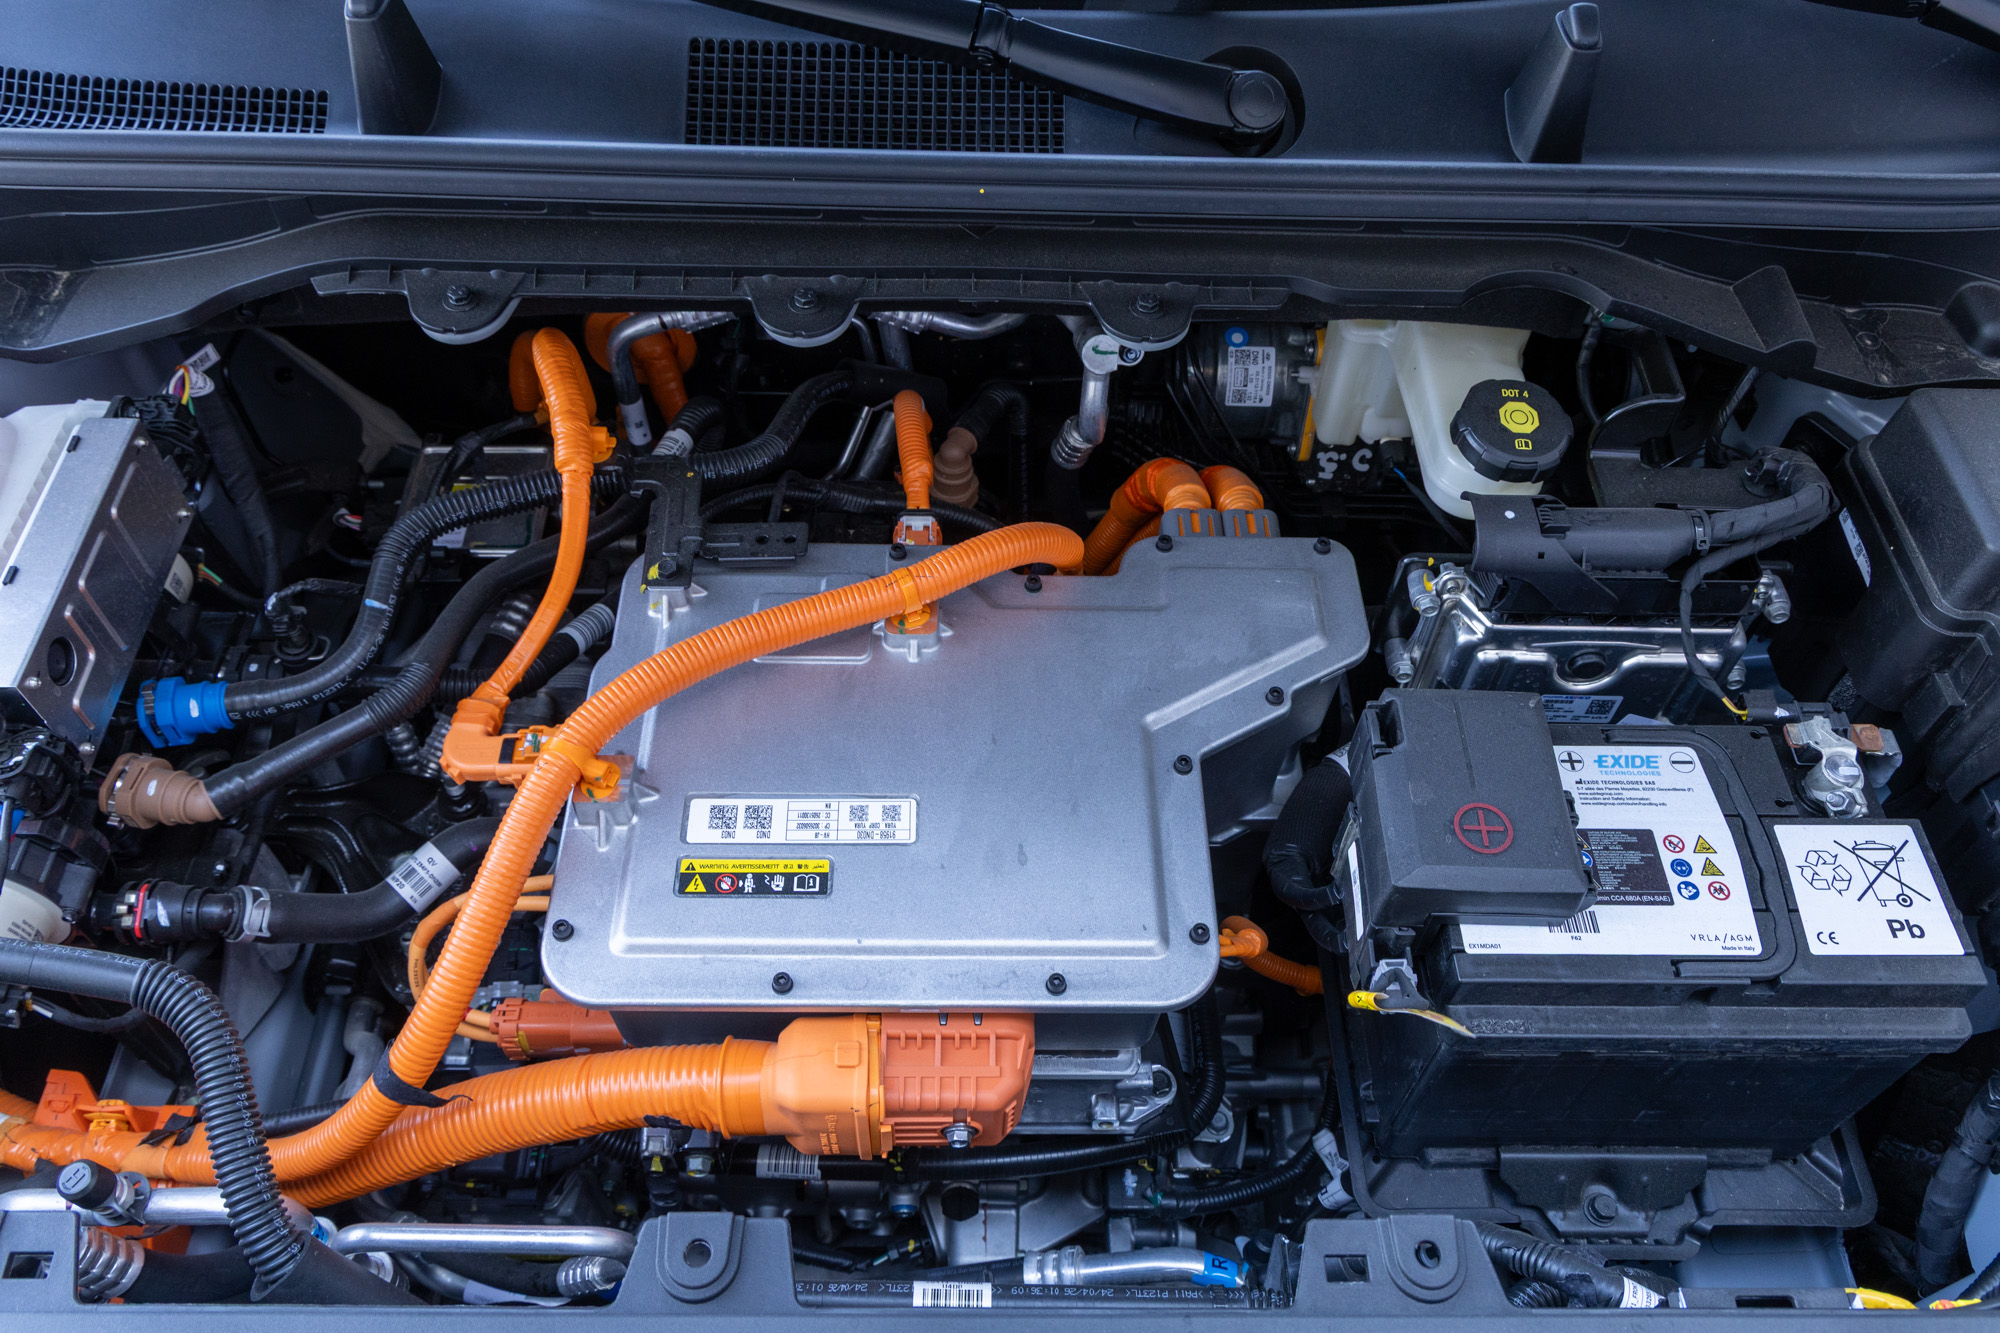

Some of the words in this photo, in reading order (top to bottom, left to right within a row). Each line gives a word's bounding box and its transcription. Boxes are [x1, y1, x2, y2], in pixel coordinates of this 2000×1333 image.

[1502, 388, 1520, 398] DOT
[1594, 754, 1660, 769] EXIDE
[720, 830, 736, 839] DN03
[756, 830, 771, 839] DN03
[427, 856, 438, 866] QV
[1886, 919, 1926, 939] Pb
[1210, 1254, 1229, 1272] R
[828, 1283, 868, 1292] 24/04/26
[1011, 1286, 1059, 1295] 01:36:09
[1064, 1286, 1114, 1296] 24/04/26
